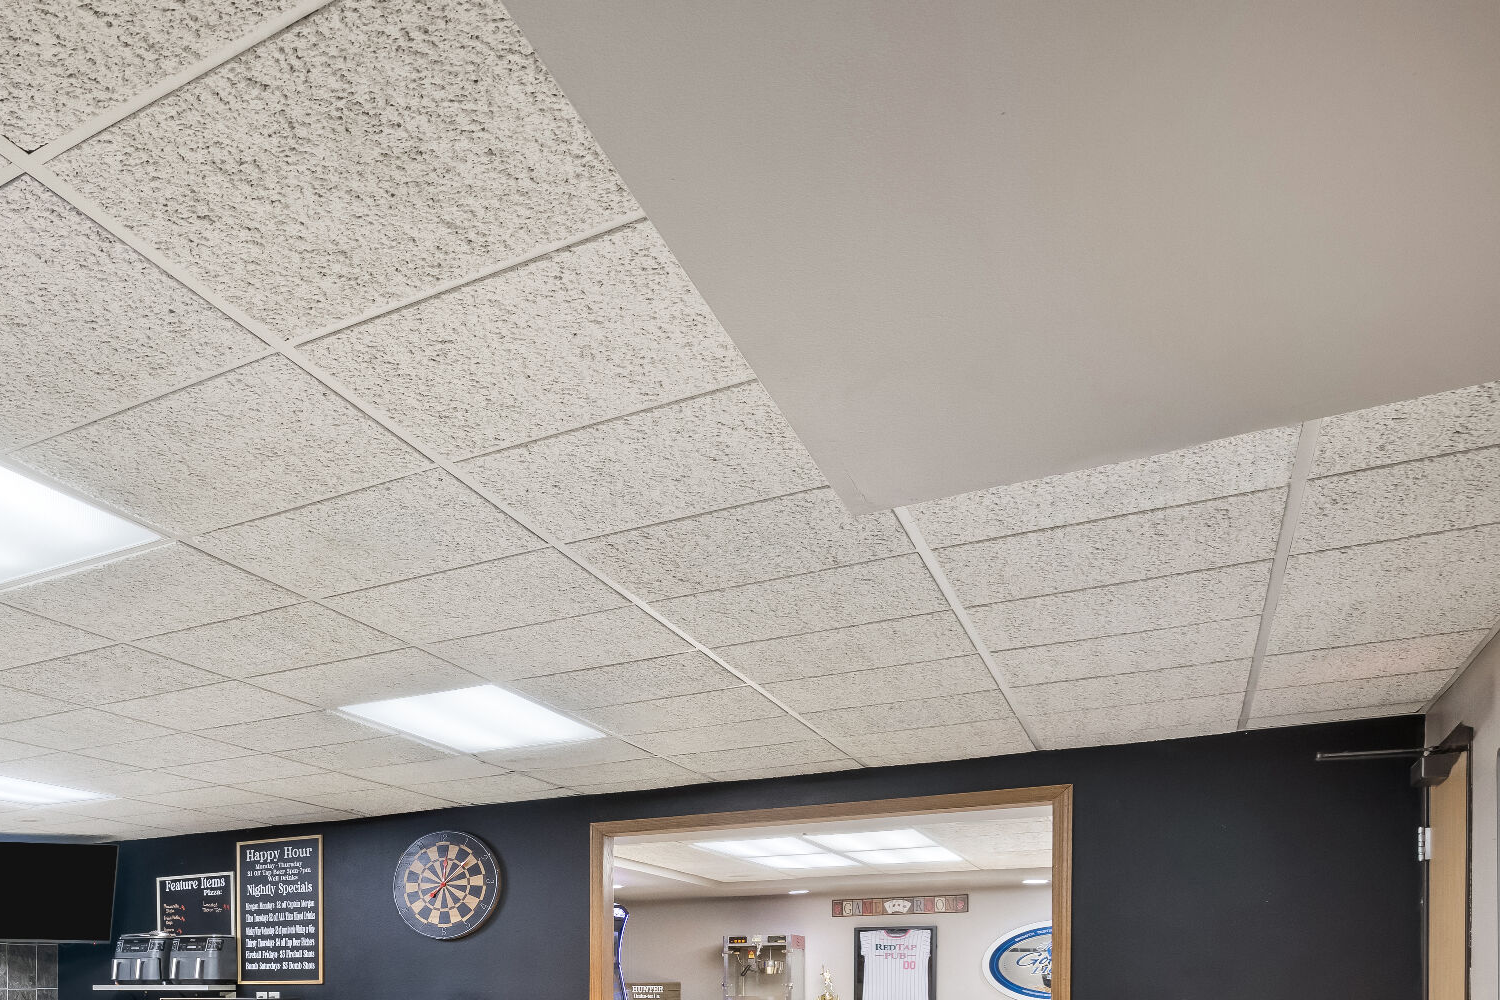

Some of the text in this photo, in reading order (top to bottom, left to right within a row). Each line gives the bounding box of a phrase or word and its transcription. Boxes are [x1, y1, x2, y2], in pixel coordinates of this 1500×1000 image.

[246, 846, 312, 862] Happy Hour
[165, 878, 225, 891] Feature Items
[247, 881, 312, 897] Nightly Specials
[843, 900, 881, 915] GAME
[903, 961, 916, 969] 00
